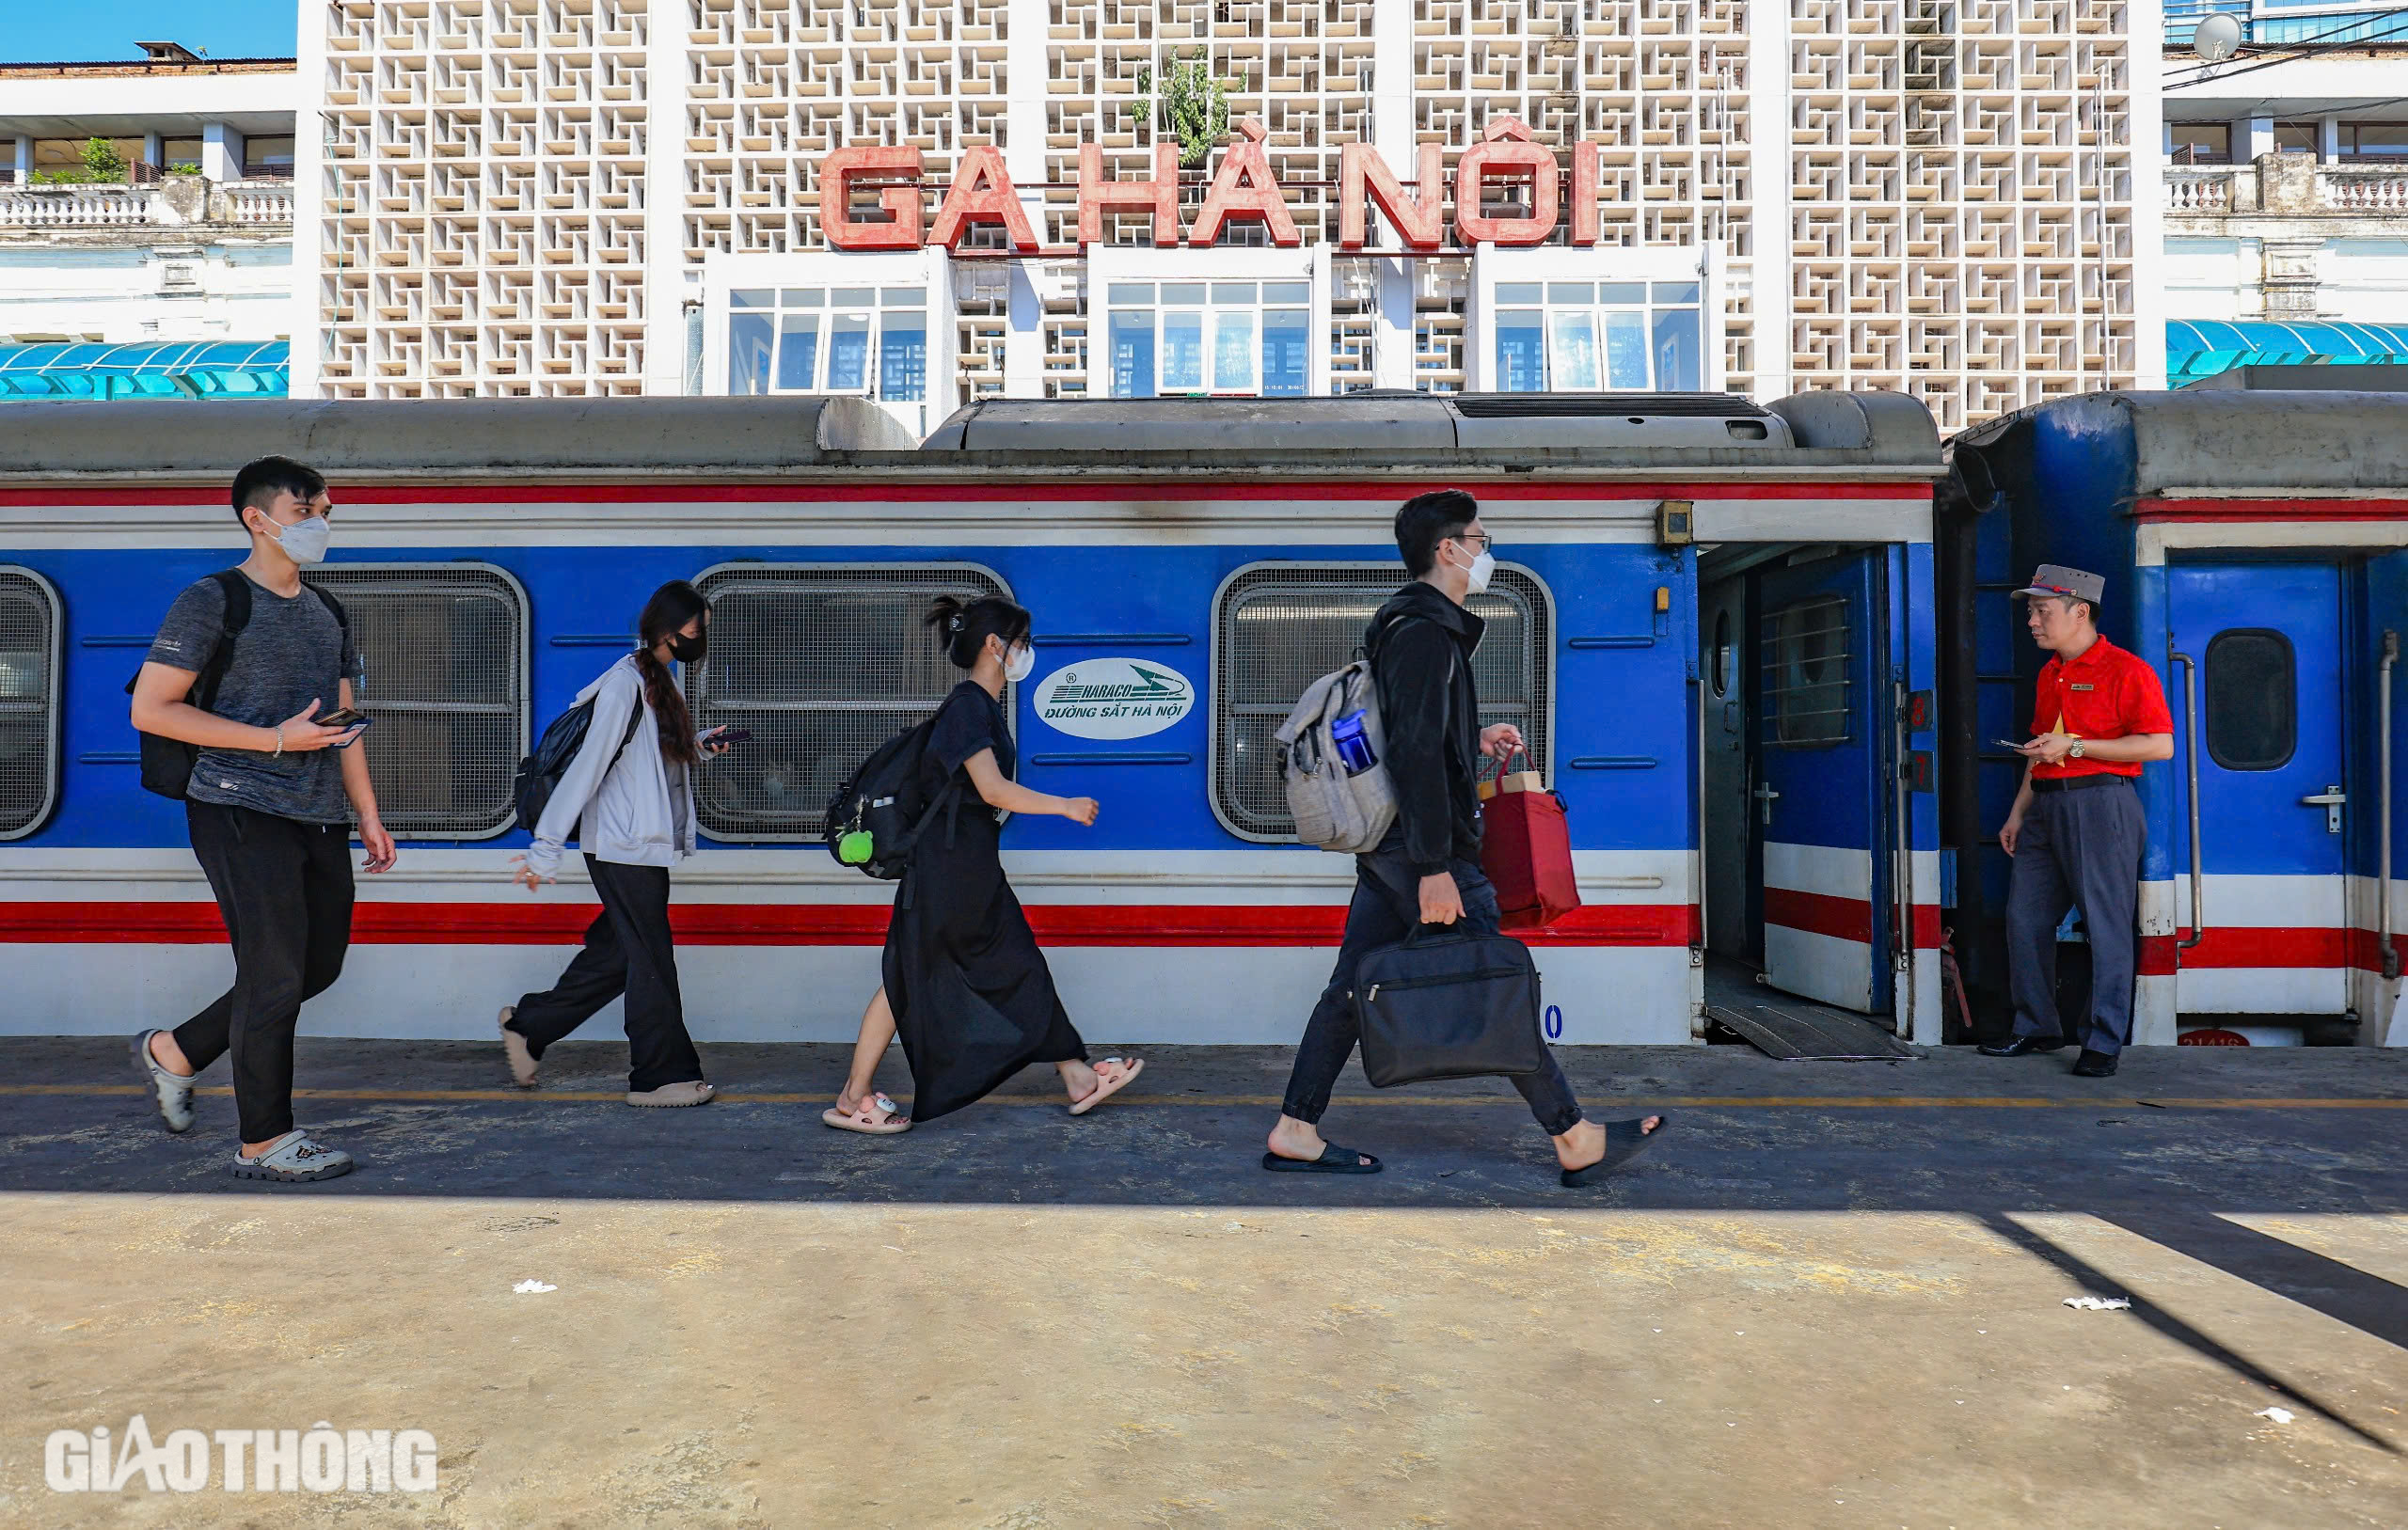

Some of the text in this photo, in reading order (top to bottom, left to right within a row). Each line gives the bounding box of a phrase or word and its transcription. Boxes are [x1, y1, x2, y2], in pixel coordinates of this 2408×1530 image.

[819, 144, 1039, 253] GA
[1078, 118, 1301, 248] HÀ
[1081, 684, 1133, 699] HARACO
[1044, 702, 1183, 719] ĐƯỜNG SẮT HÀ NỘI
[1911, 697, 1925, 726] 8
[1916, 755, 1926, 785] 7
